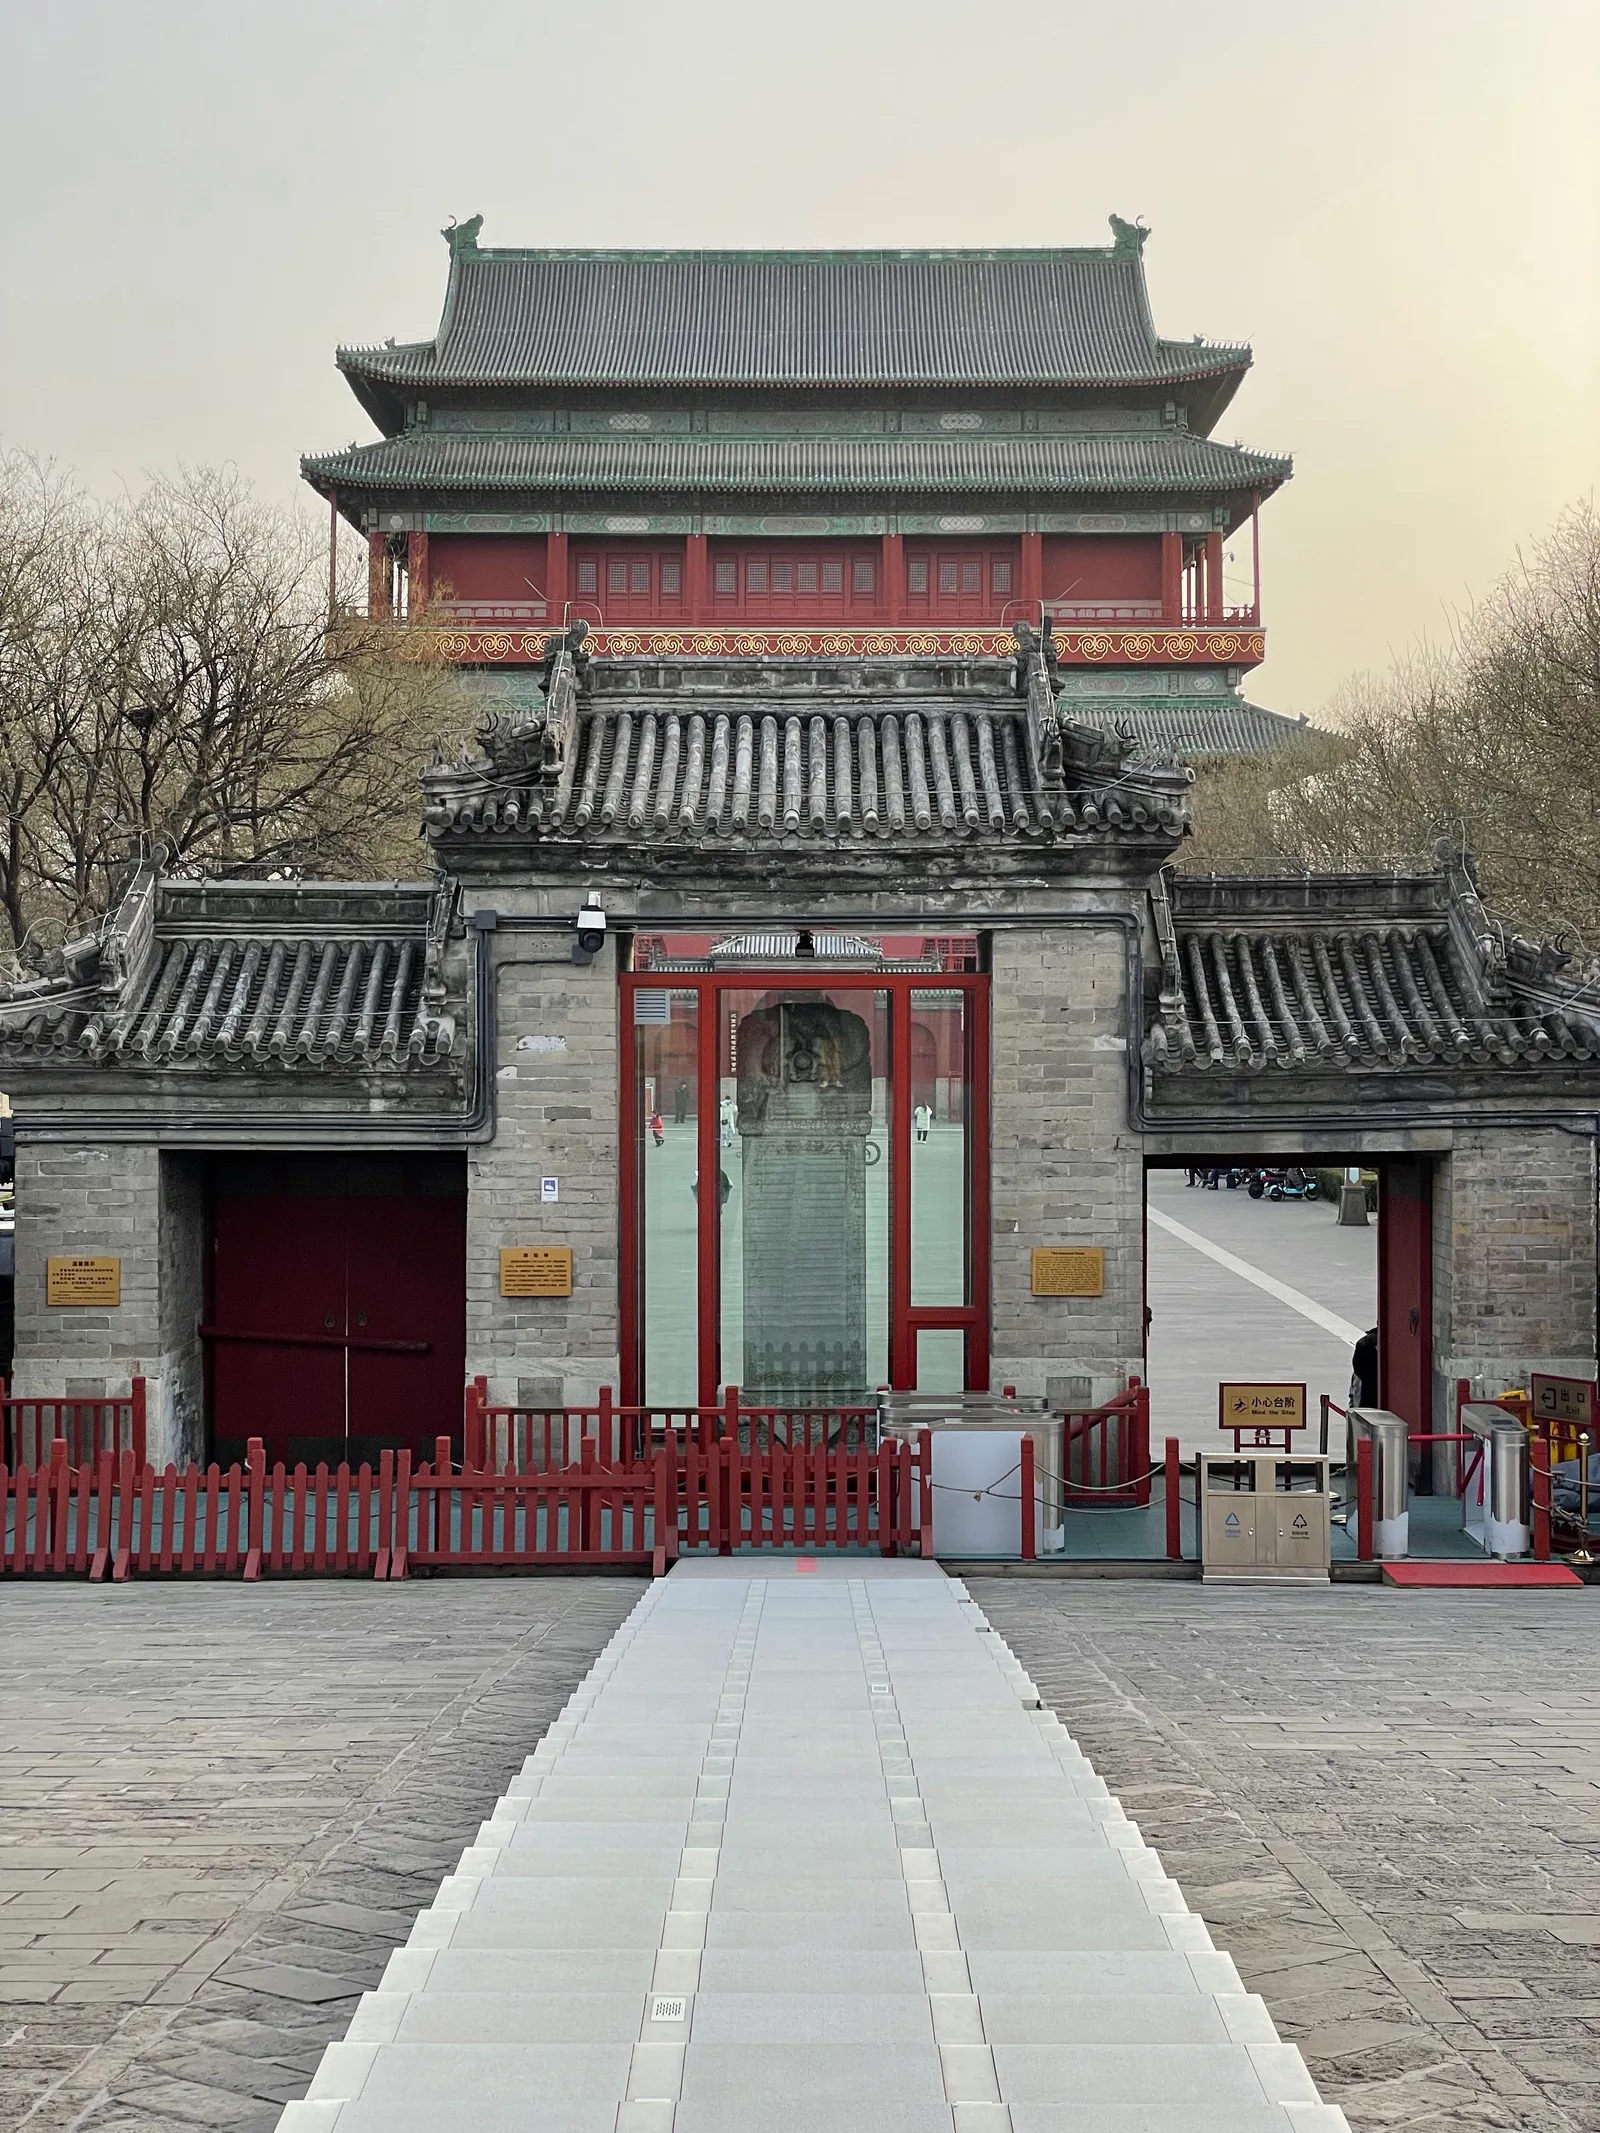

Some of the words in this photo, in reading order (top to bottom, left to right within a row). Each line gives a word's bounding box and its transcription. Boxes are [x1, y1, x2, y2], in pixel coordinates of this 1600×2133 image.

[1561, 1389, 1585, 1403] 出口
[1252, 1397, 1296, 1408] 小心台阶
[1566, 1406, 1580, 1415] Exit
